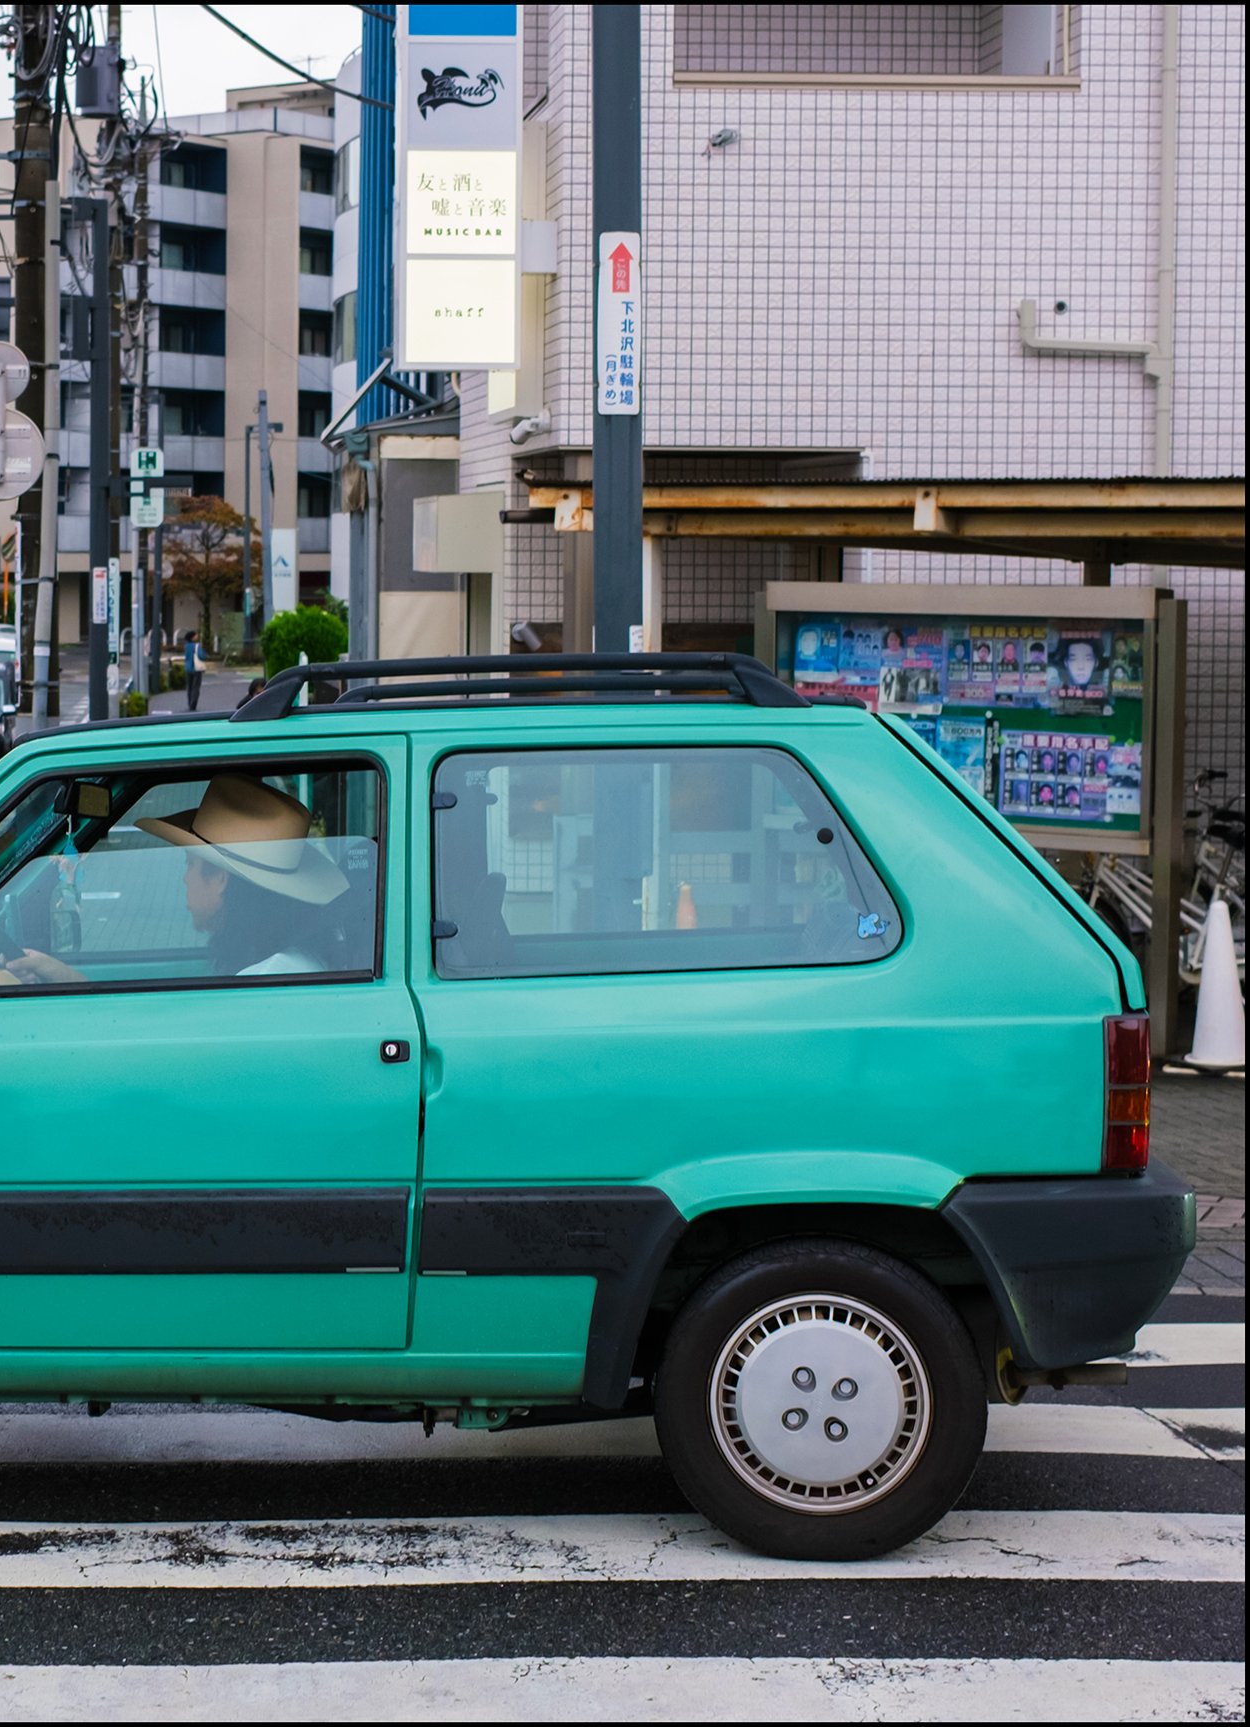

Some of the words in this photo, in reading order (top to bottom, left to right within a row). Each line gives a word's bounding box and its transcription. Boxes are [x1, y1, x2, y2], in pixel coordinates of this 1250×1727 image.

[417, 173, 483, 192] 友と酒と
[431, 198, 507, 217] 嘘と音楽
[424, 228, 469, 236] MUSIC
[475, 228, 502, 236] BAR
[620, 301, 635, 406] 下北沢駐輪場
